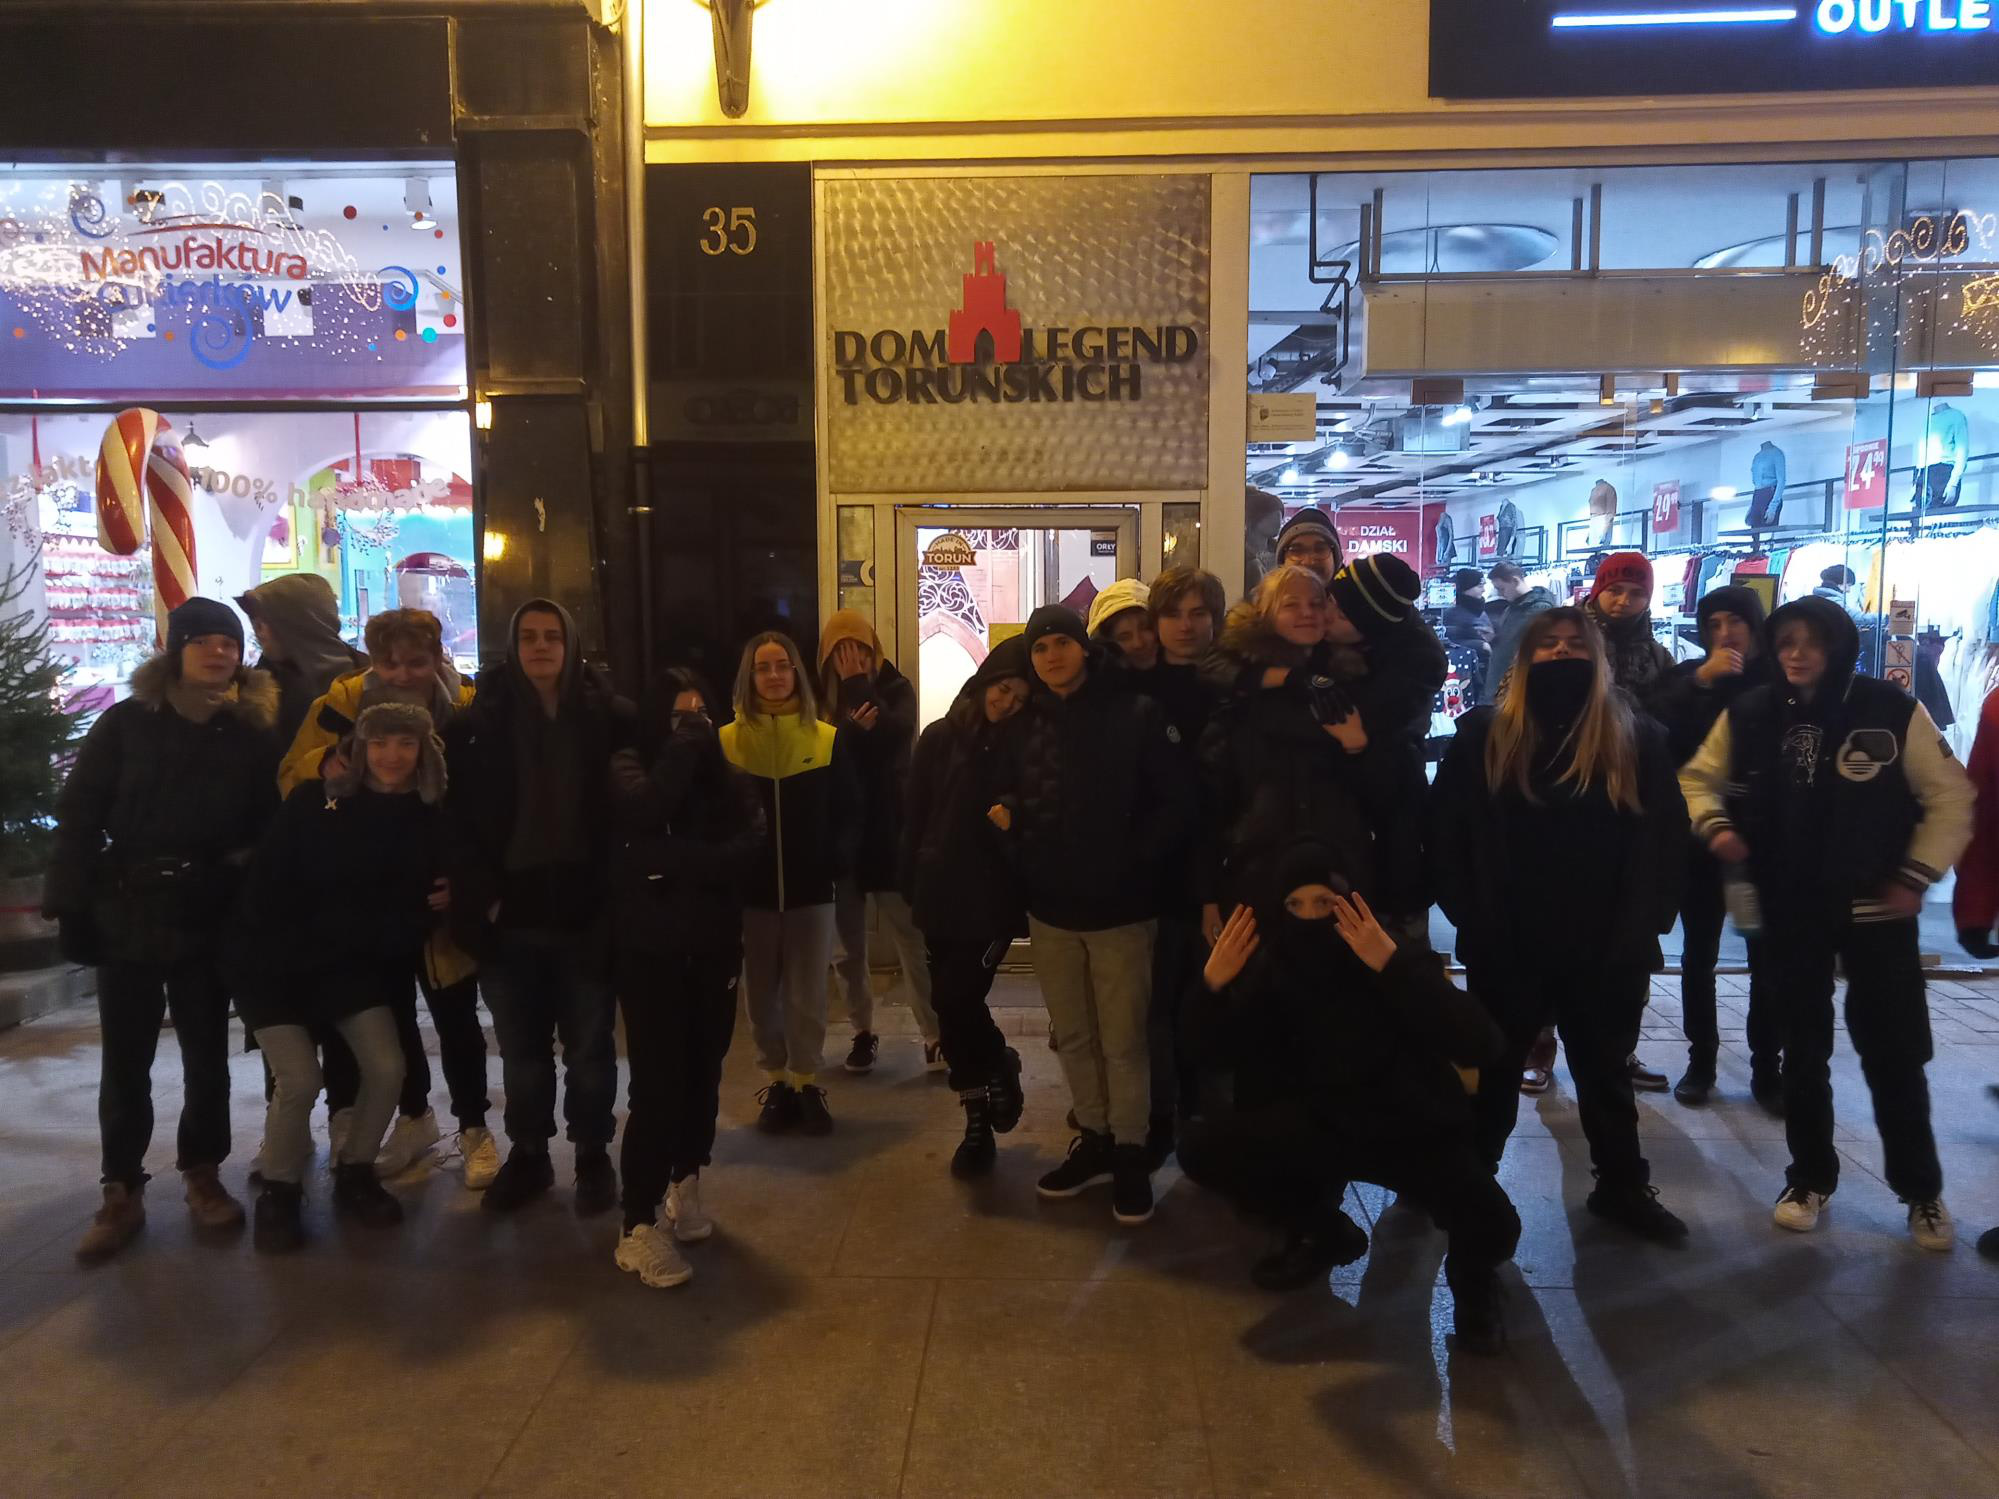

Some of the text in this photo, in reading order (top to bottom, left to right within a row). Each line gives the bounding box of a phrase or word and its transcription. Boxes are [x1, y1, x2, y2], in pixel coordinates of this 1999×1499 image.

[1816, 0, 1991, 33] OUTLE
[700, 207, 757, 255] 35
[80, 236, 307, 281] Manufaktura
[834, 326, 1198, 366] DOM LEGEND
[1348, 539, 1408, 553] DAMSKI
[1360, 525, 1396, 537] DZIAŁ
